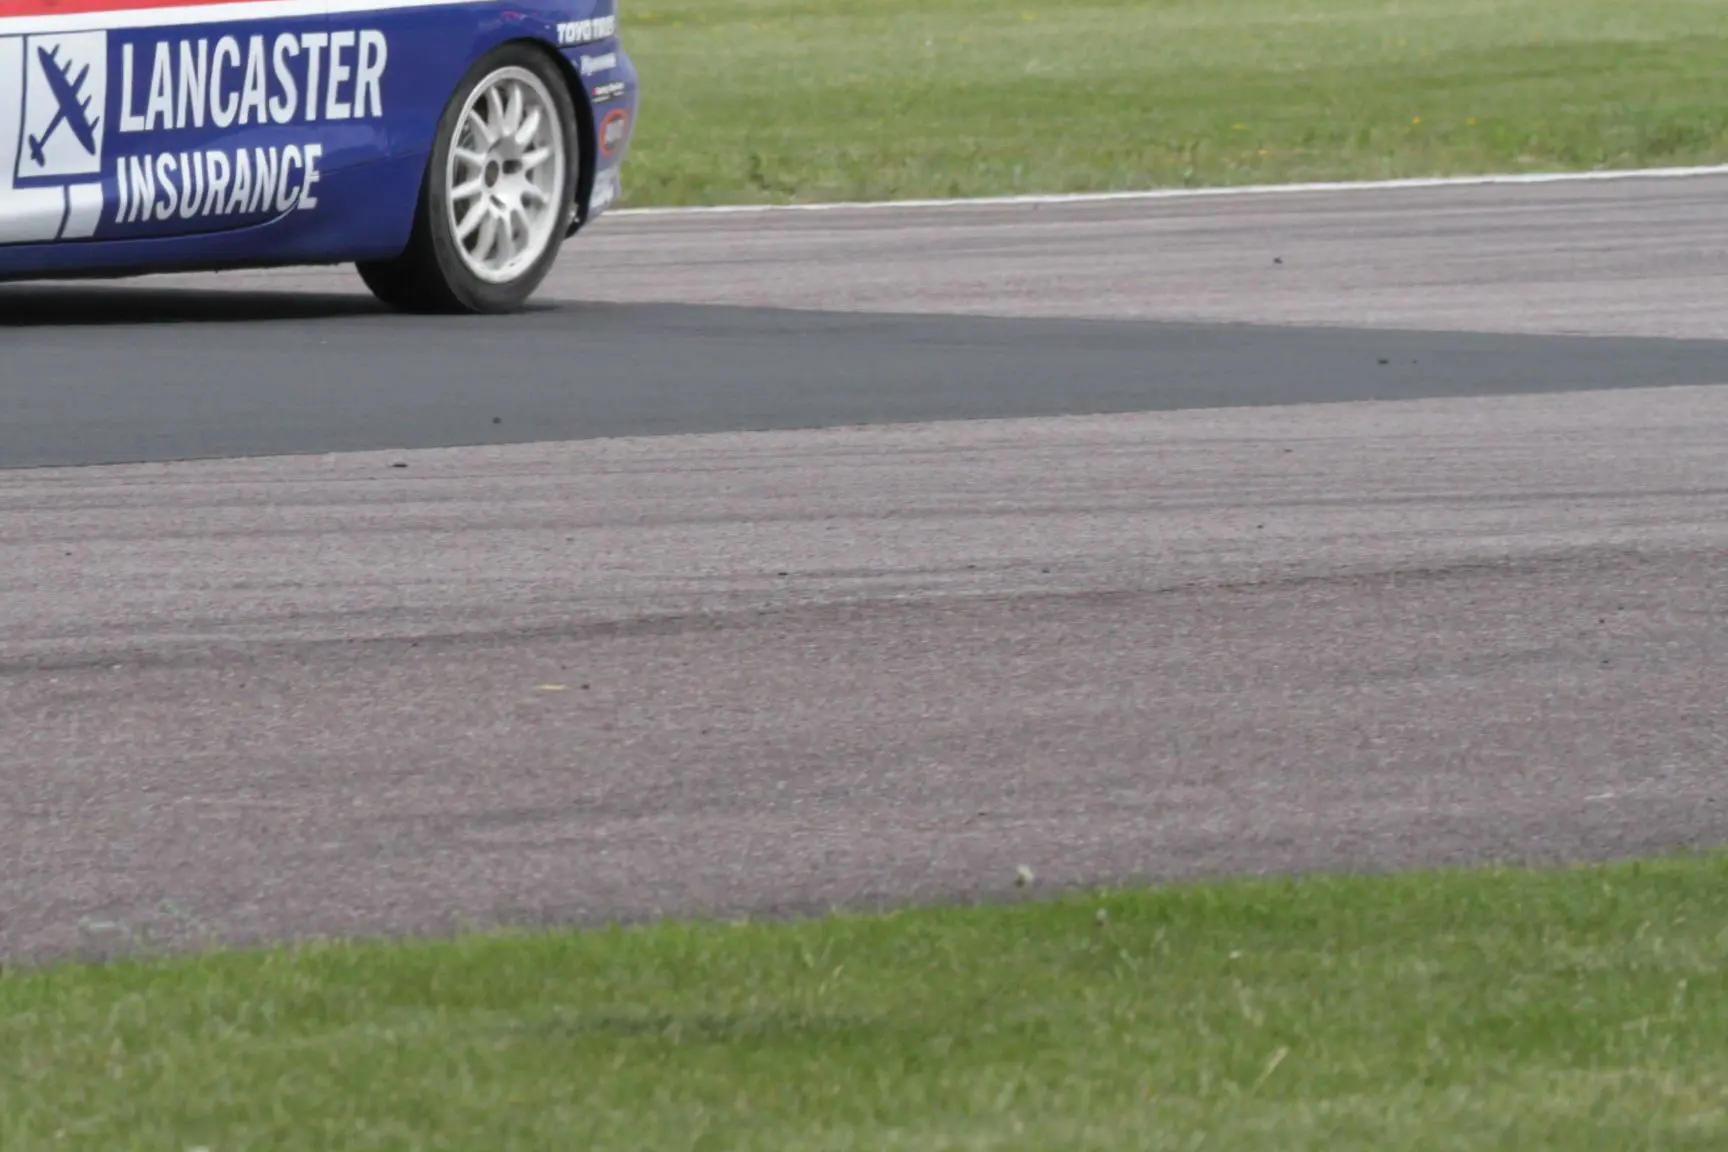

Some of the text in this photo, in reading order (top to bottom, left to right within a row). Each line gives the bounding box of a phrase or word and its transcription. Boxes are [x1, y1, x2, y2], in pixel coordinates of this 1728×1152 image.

[556, 19, 592, 45] TOYO
[119, 29, 388, 133] LANCASTER
[115, 143, 322, 223] INSURANCE
